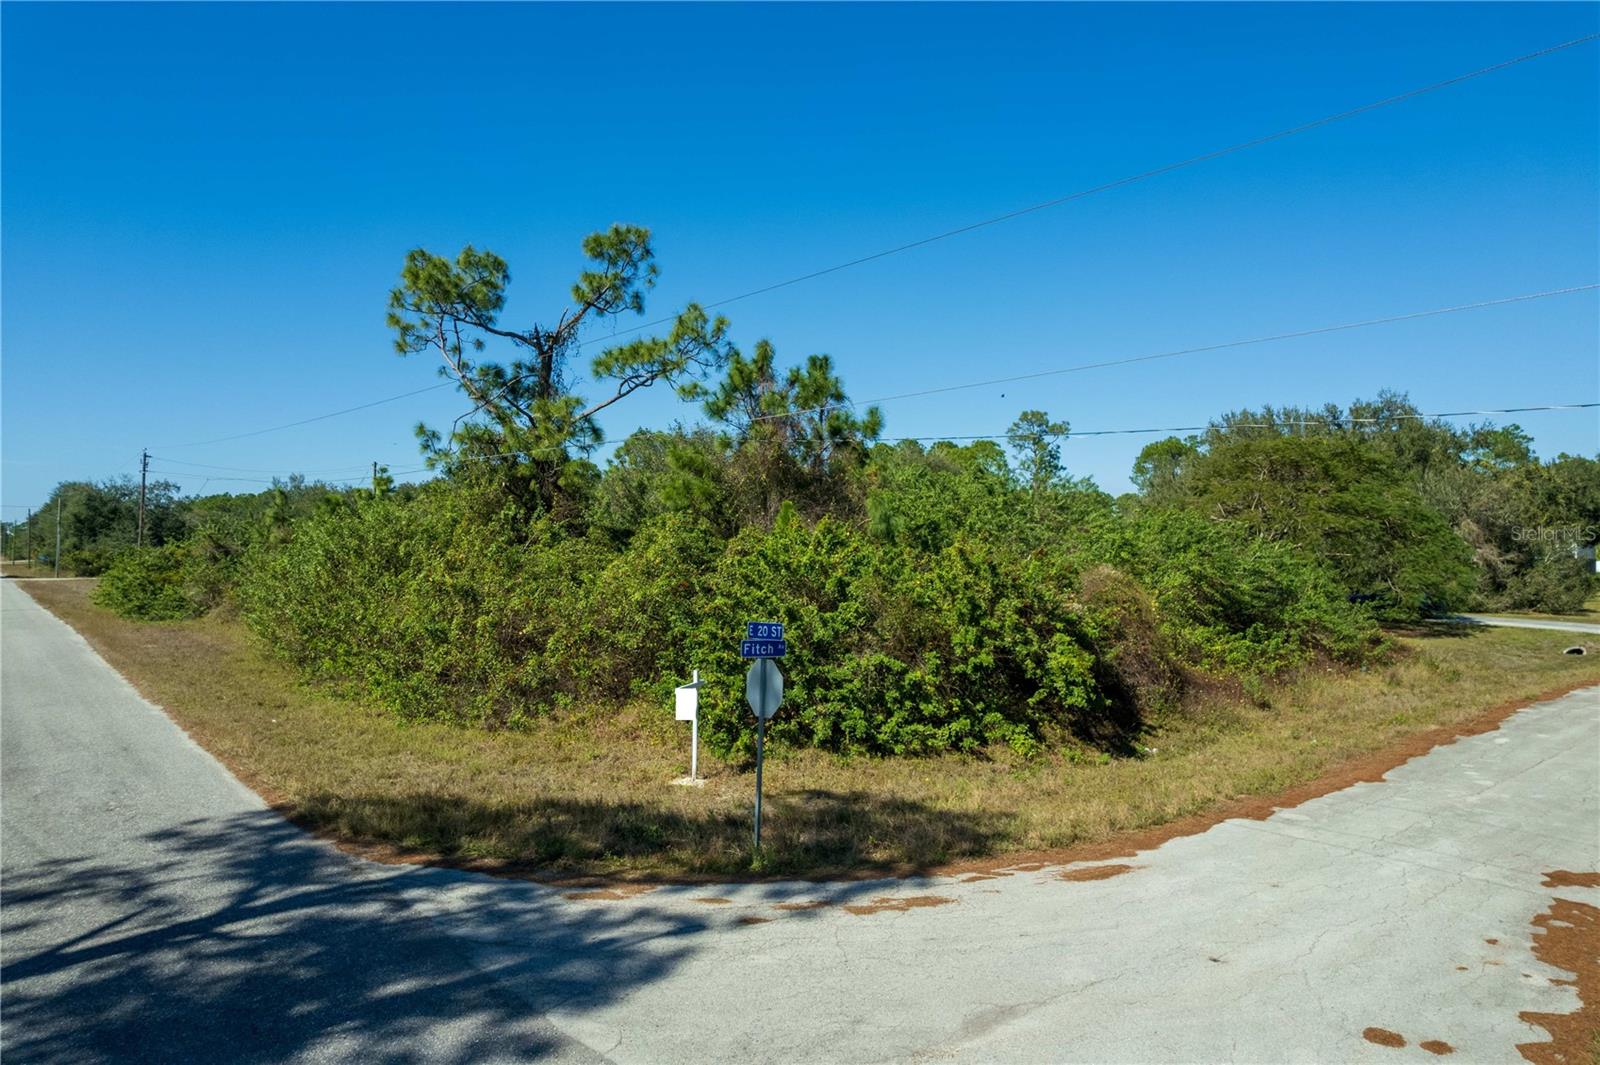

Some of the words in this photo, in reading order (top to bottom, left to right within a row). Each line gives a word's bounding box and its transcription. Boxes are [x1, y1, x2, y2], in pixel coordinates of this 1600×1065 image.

[749, 625, 754, 636] E
[757, 625, 768, 637] 20
[771, 625, 782, 638] ST
[743, 643, 774, 655] Fitch
